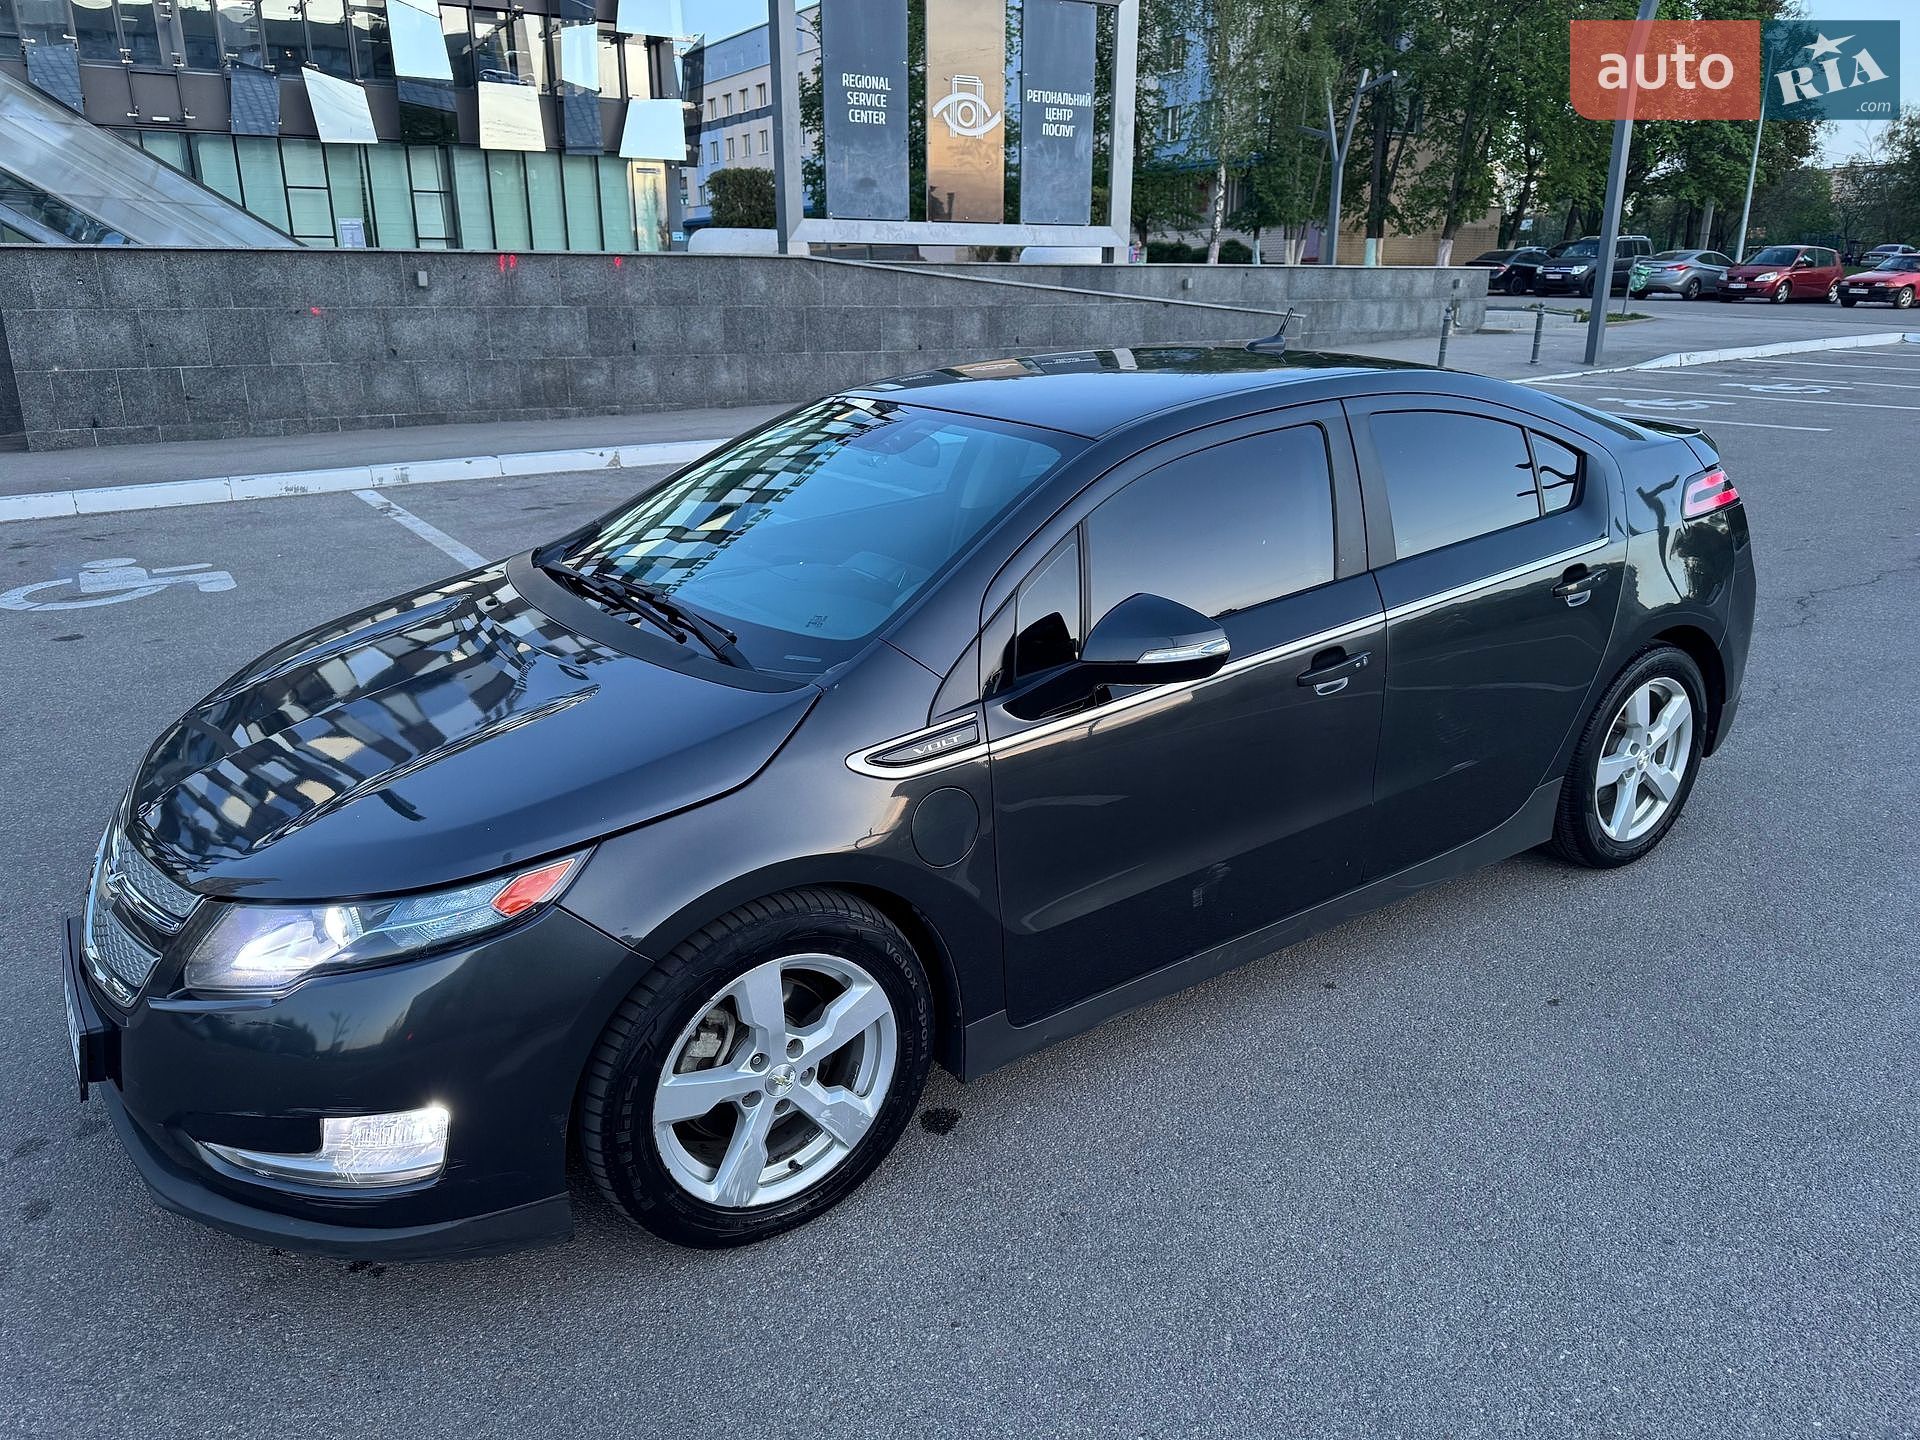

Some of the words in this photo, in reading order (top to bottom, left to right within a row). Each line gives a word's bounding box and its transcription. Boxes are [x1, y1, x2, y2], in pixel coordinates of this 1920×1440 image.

[842, 72, 892, 91] REGIONAL
[847, 91, 887, 108] SERVICE
[1026, 90, 1092, 107] РЕГІОНАЛЬНИЙ
[848, 108, 886, 125] CENTER
[1045, 107, 1074, 122] ЦЕНТР
[1042, 122, 1076, 138] ПОСЛУГ
[912, 734, 962, 755] VOLT
[884, 942, 919, 990] Velox
